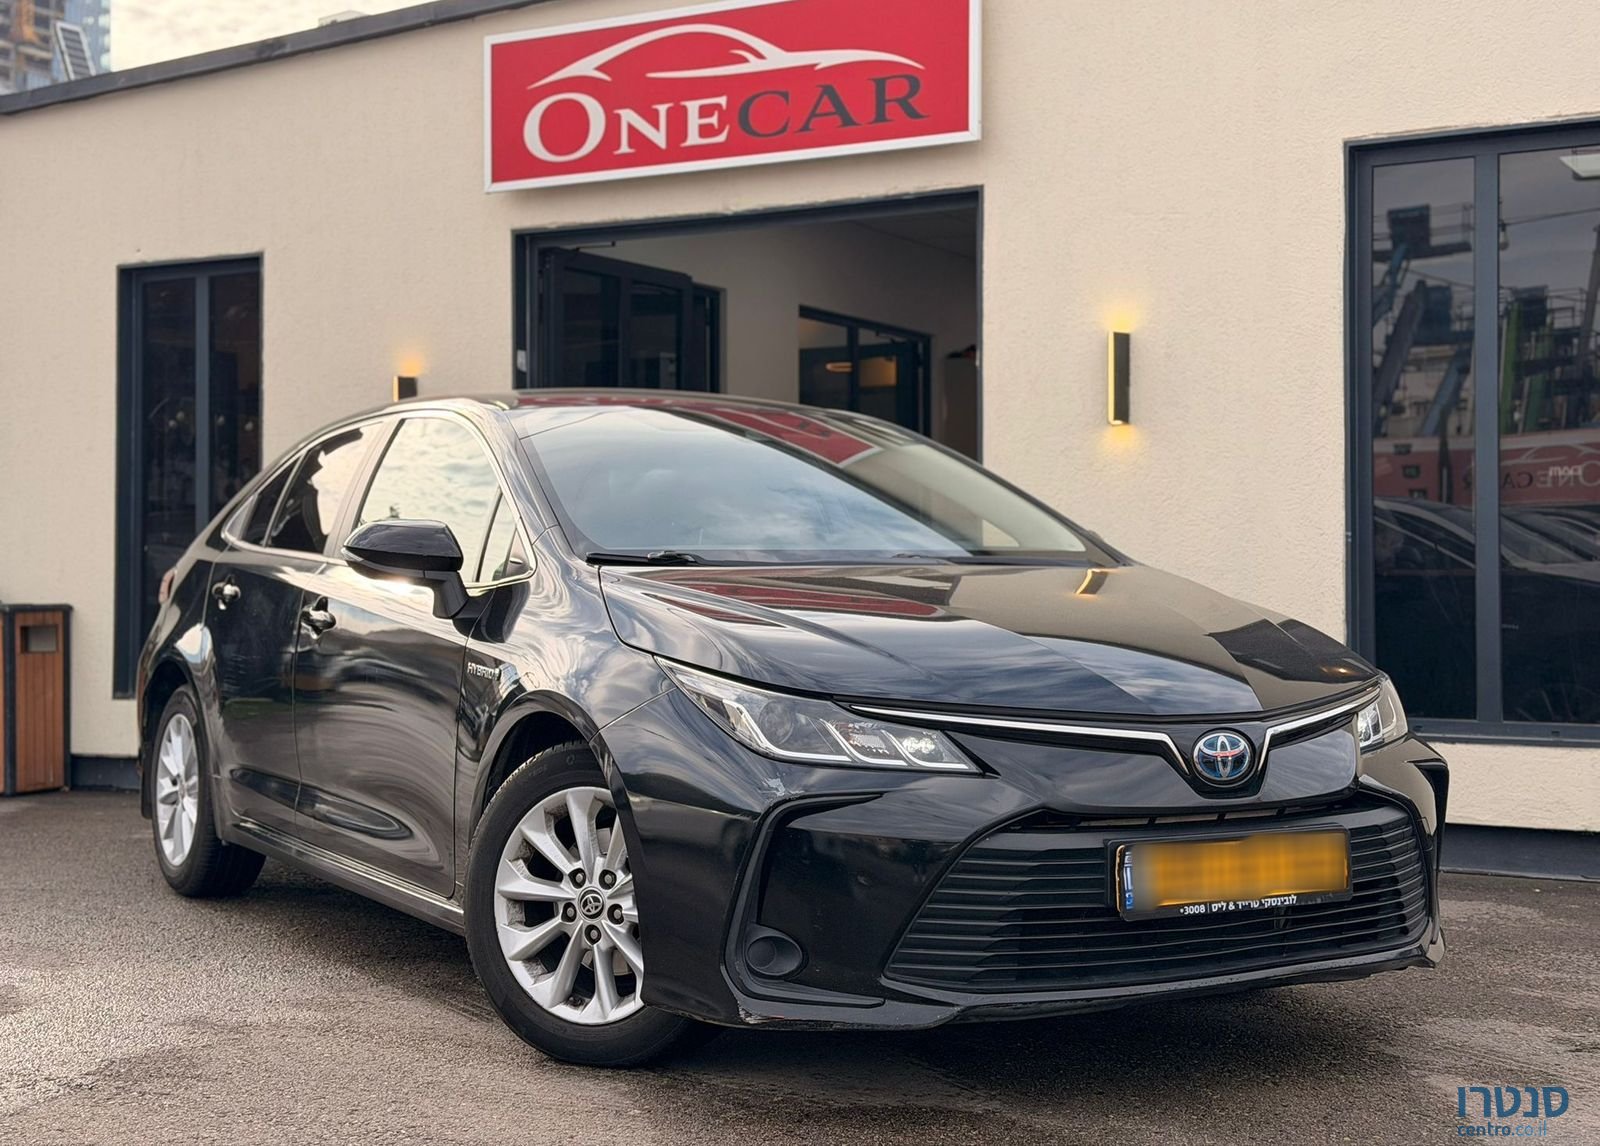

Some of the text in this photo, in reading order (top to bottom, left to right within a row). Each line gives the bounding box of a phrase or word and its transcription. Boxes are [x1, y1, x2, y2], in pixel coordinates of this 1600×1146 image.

[467, 662, 494, 679] HYBRID
[1211, 901, 1227, 912] ליס
[1228, 901, 1235, 911] &
[1236, 900, 1260, 909] טרייד
[1261, 894, 1297, 908] לובינסקי
